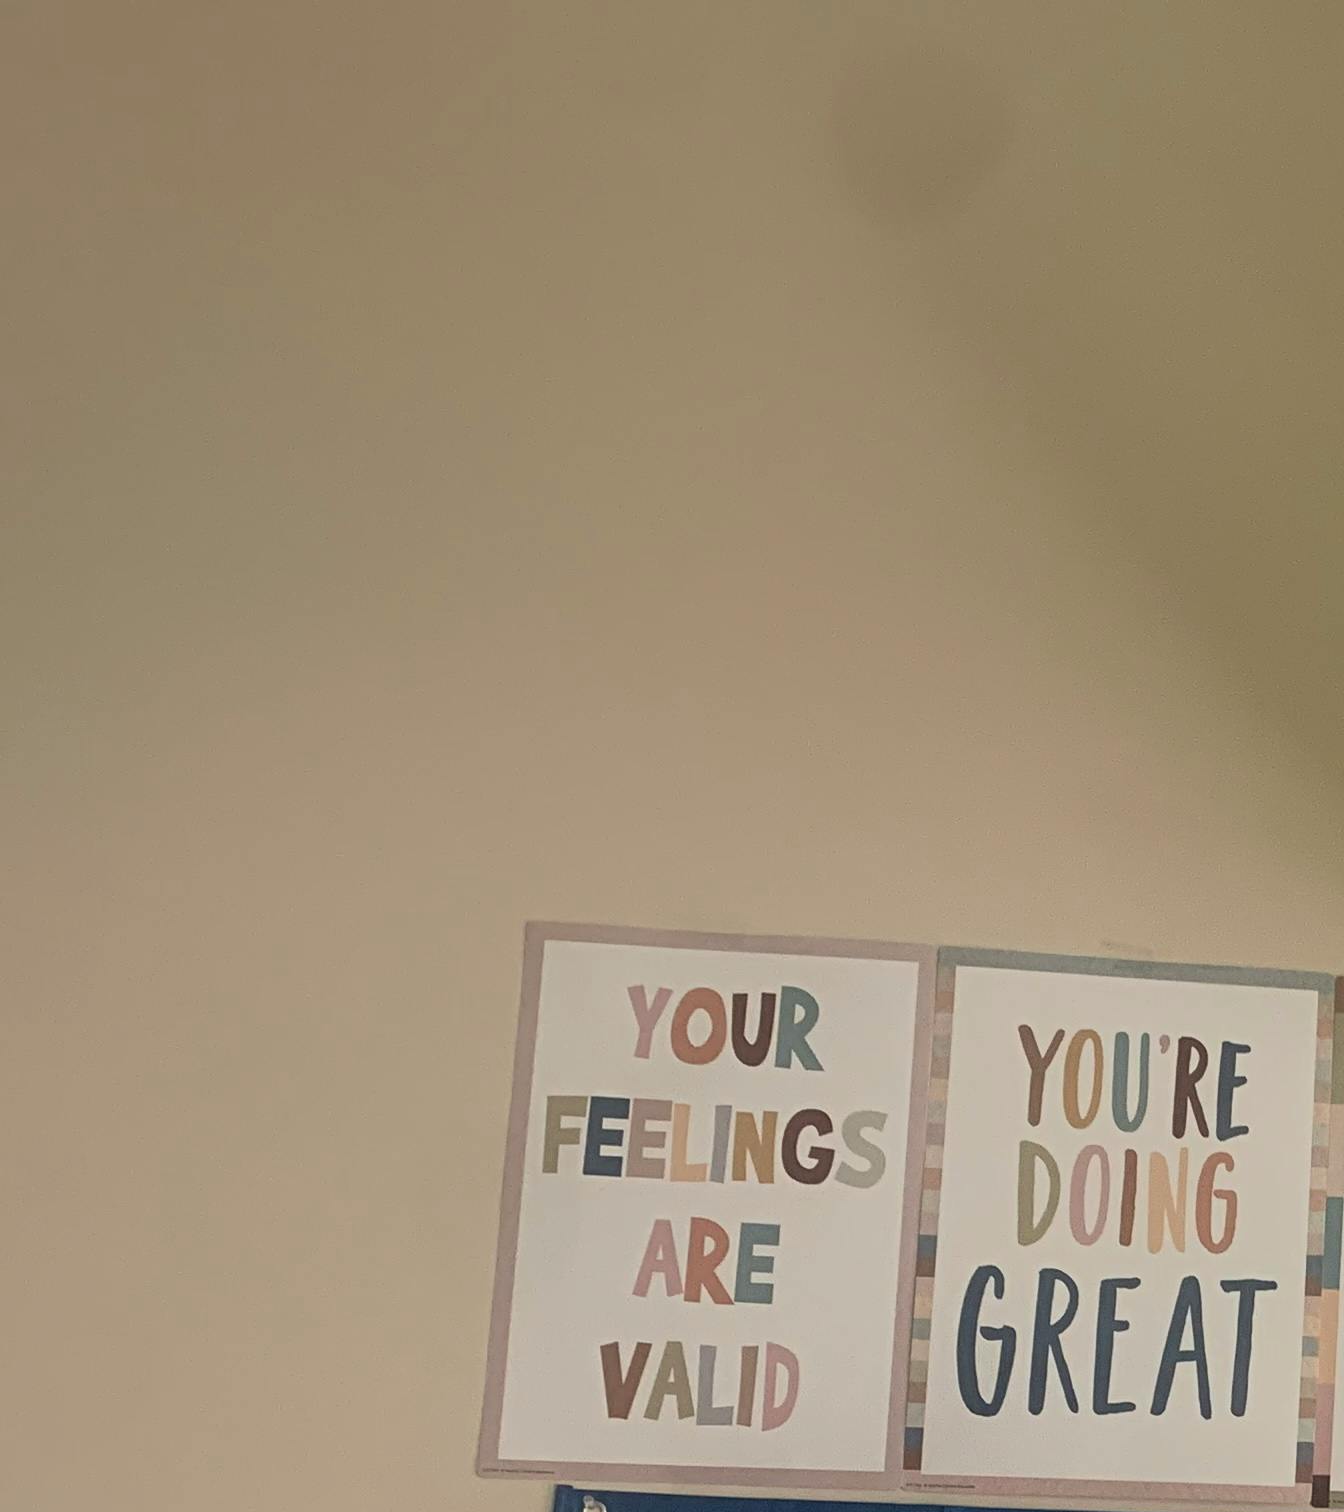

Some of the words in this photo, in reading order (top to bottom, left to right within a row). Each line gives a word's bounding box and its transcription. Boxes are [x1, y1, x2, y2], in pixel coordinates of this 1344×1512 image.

[627, 984, 825, 1072] YOUR
[1017, 1024, 1252, 1142] YOU'RE
[542, 1094, 889, 1190] FEELINGS
[1016, 1139, 1238, 1254] DOING
[631, 1216, 782, 1306] ARE
[600, 1341, 800, 1432] VALID
[955, 1264, 1278, 1421] GREAT
